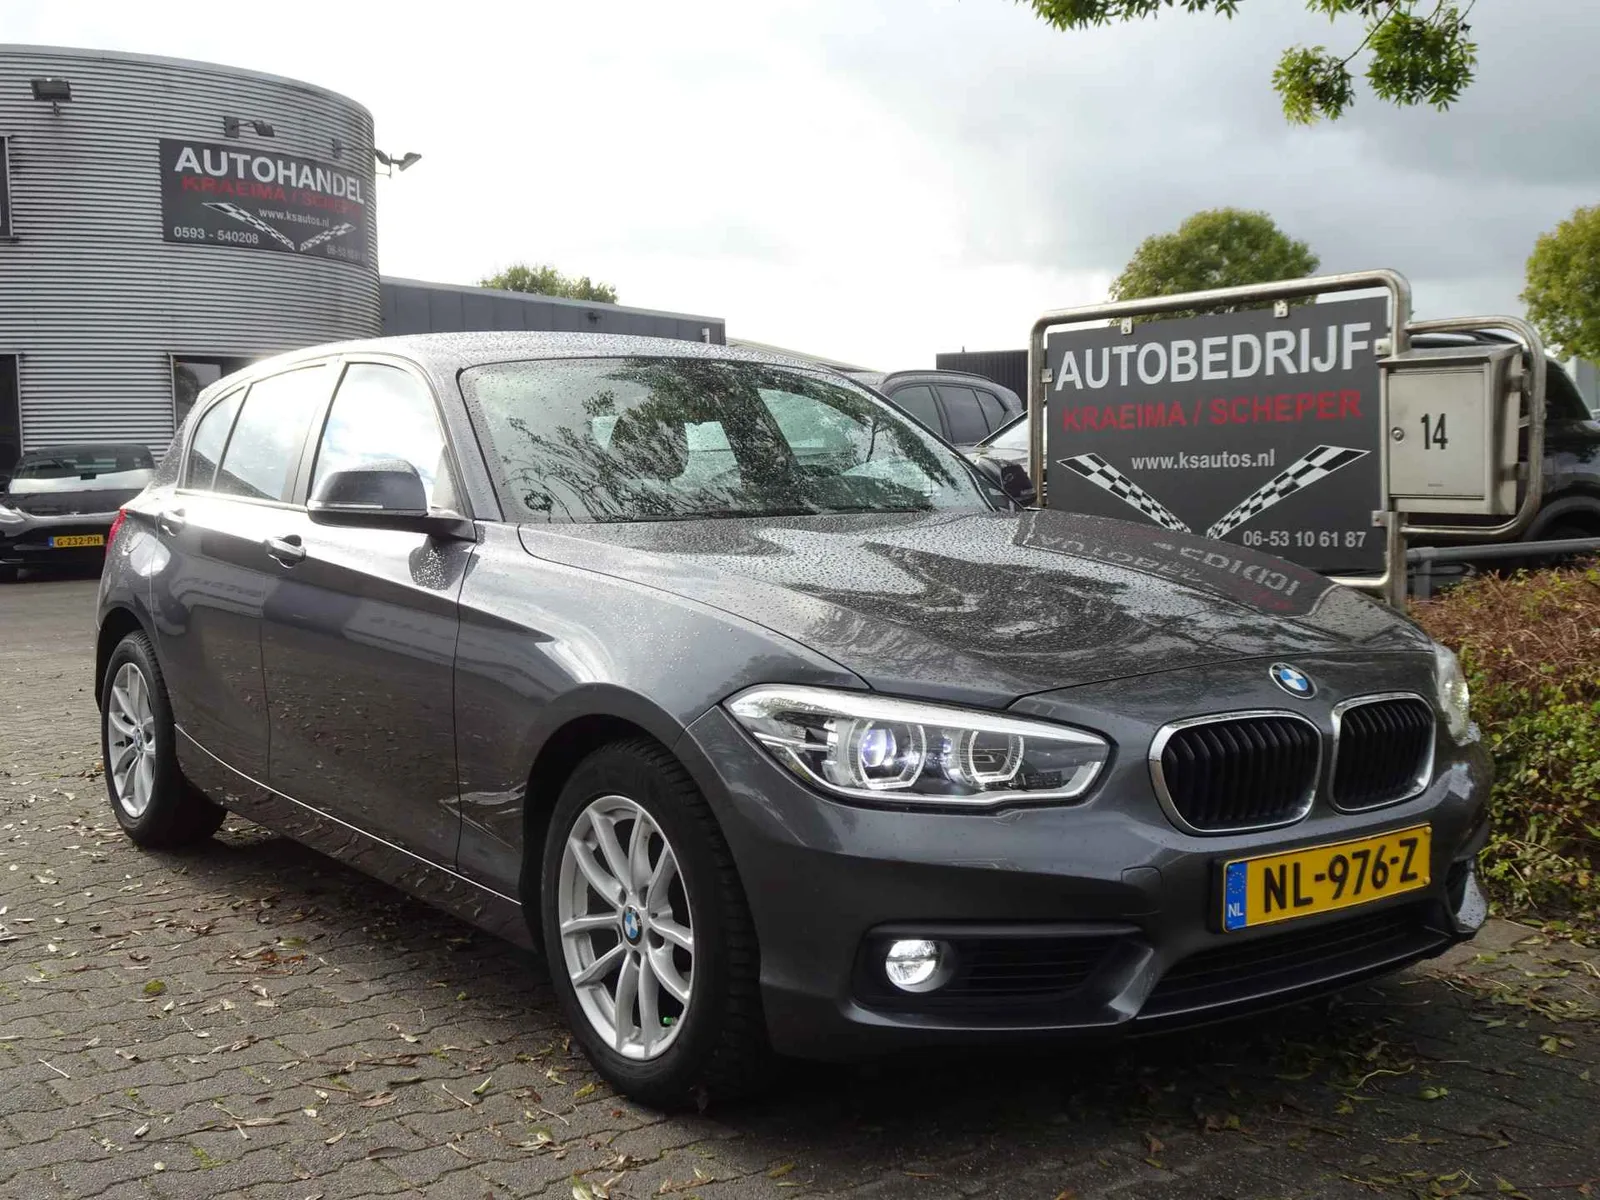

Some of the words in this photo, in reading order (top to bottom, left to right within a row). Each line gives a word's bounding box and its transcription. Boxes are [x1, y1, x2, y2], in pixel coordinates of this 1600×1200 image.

[174, 146, 365, 205] AUTOHANDEL
[181, 175, 286, 202] KRAEIMA
[173, 225, 206, 240] 0593
[217, 229, 259, 244] 540208
[1054, 321, 1372, 392] AUTOBEDRIJF
[1062, 400, 1188, 432] KRAEIMA
[1209, 390, 1364, 426] SCHEPER
[1420, 412, 1449, 451] 14
[1131, 448, 1276, 470] www.ksautos.nl
[1242, 530, 1290, 547] 06-53
[1294, 530, 1316, 548] 10
[1319, 530, 1339, 548] 61
[1344, 530, 1368, 548] 87
[1228, 902, 1244, 918] NL
[1263, 837, 1419, 914] NL-976-Z
